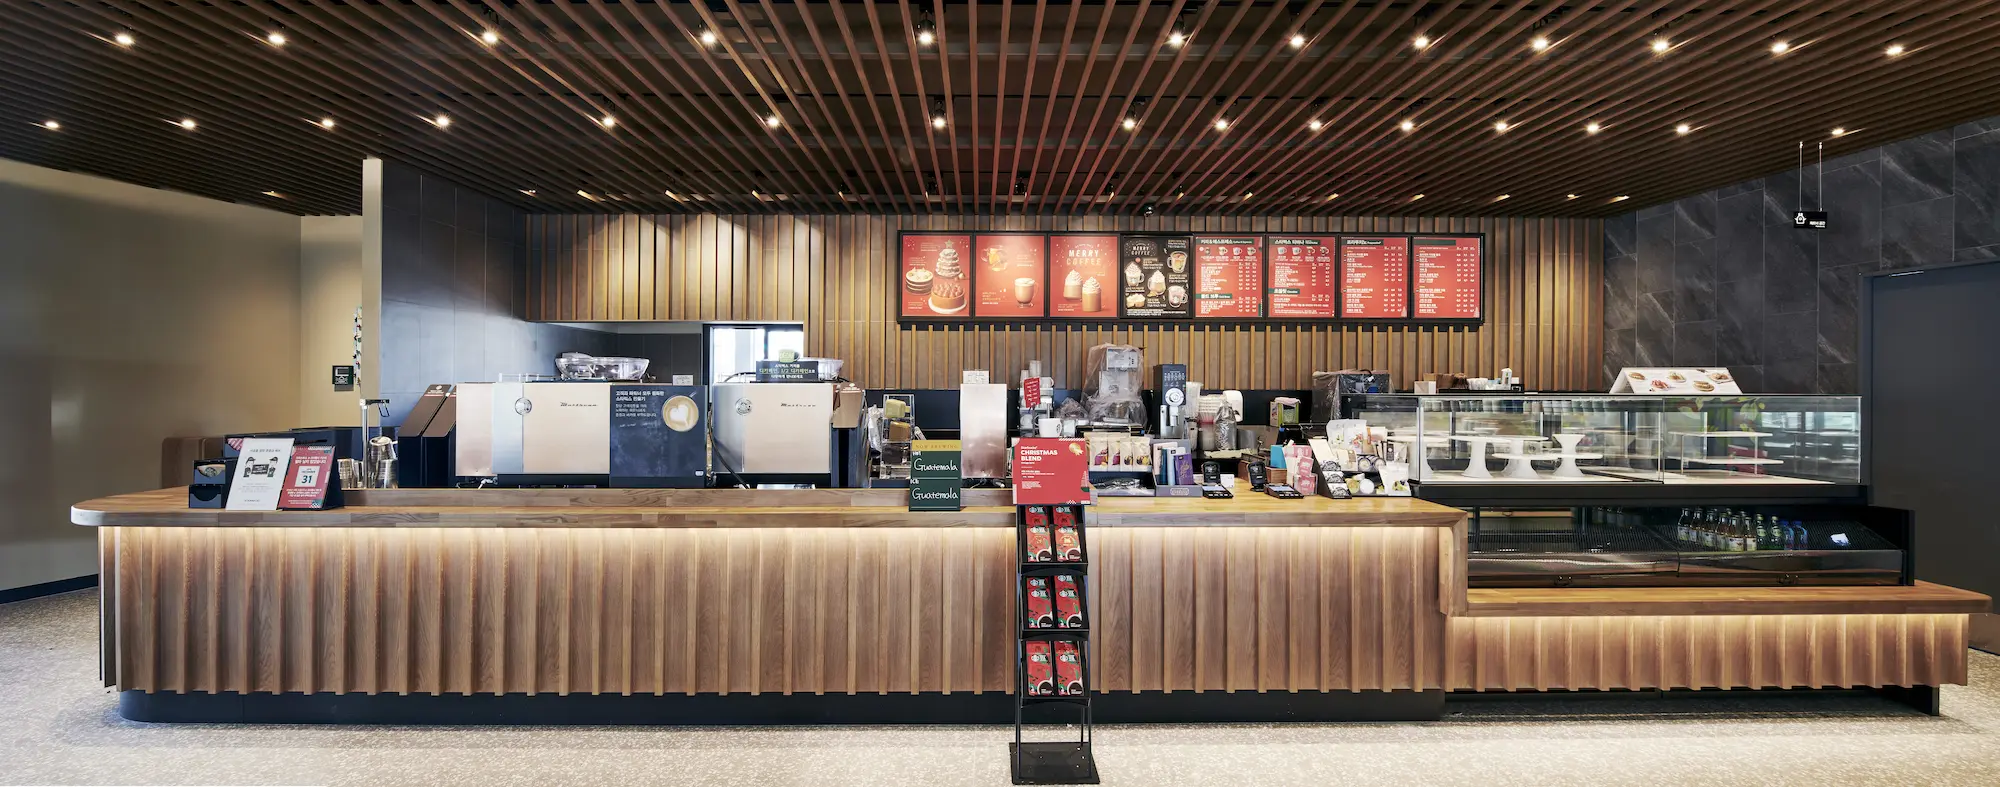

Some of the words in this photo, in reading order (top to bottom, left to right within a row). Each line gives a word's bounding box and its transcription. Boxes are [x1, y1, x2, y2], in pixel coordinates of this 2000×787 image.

[1068, 249, 1100, 258] MERRY
[1066, 257, 1102, 266] COFFEE
[913, 458, 959, 472] Guatemala
[301, 475, 313, 484] 31
[911, 488, 959, 501] Guatemala
